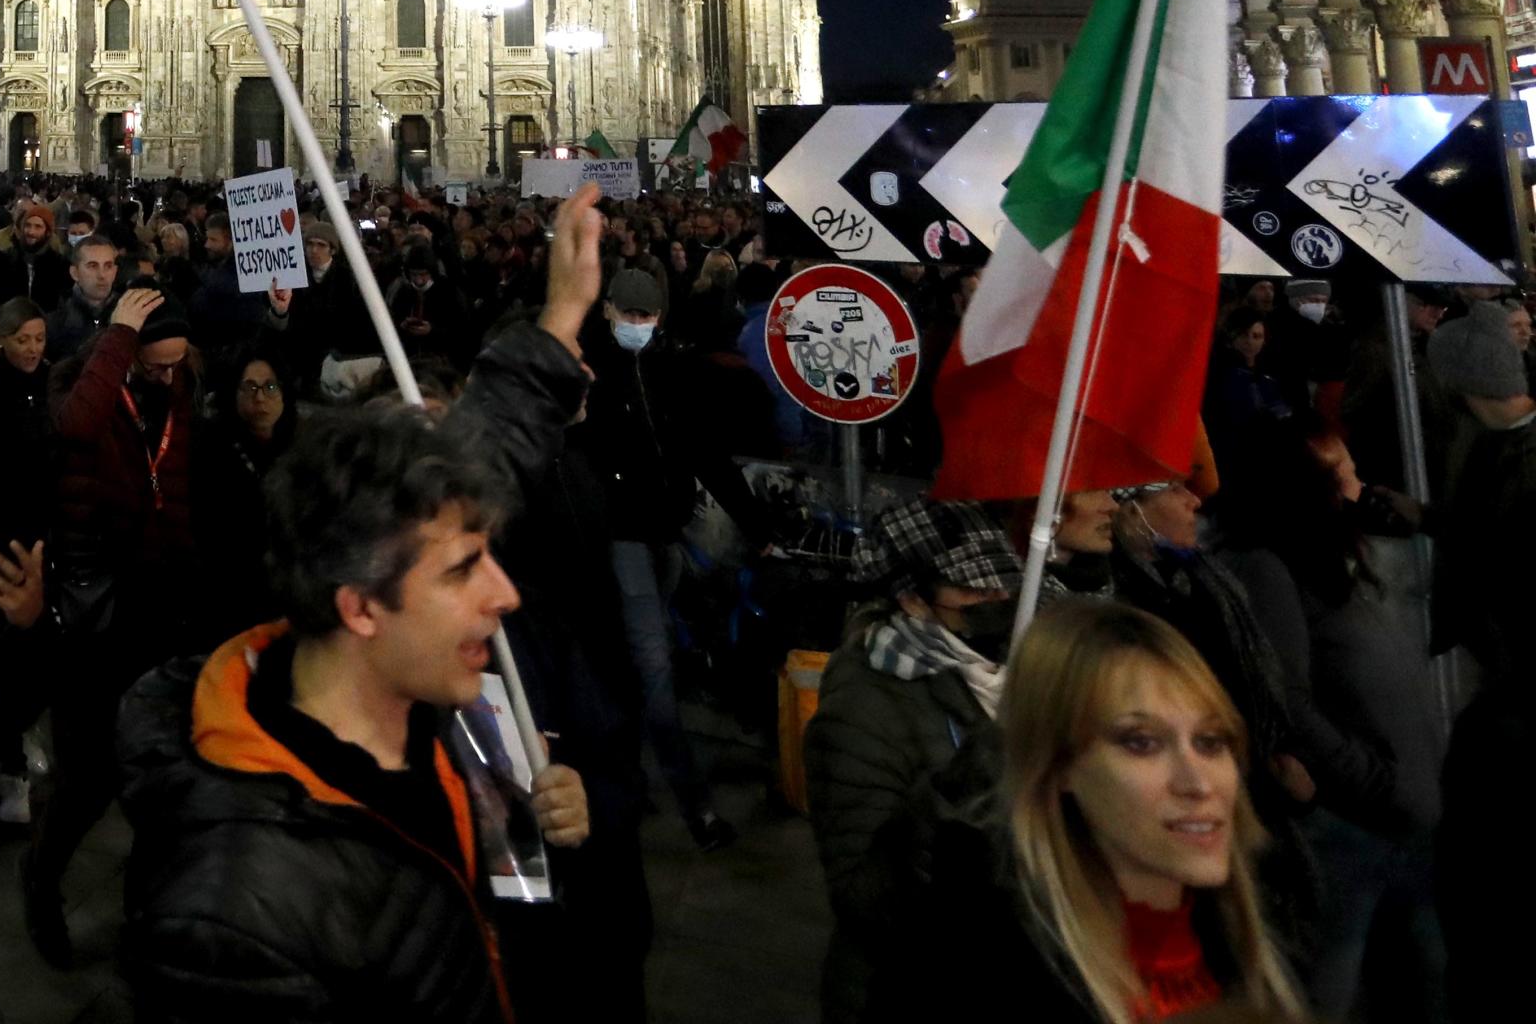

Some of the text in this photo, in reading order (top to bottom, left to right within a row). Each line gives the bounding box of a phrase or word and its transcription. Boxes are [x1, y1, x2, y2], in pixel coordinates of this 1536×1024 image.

[1431, 53, 1484, 85] M
[582, 161, 633, 172] SIAMO TUTTI
[228, 185, 257, 207] TRIESTE
[257, 181, 284, 202] CHIAMA
[233, 215, 283, 243] L'ITALIA
[237, 246, 297, 276] RISPONDE
[889, 344, 911, 355] diez
